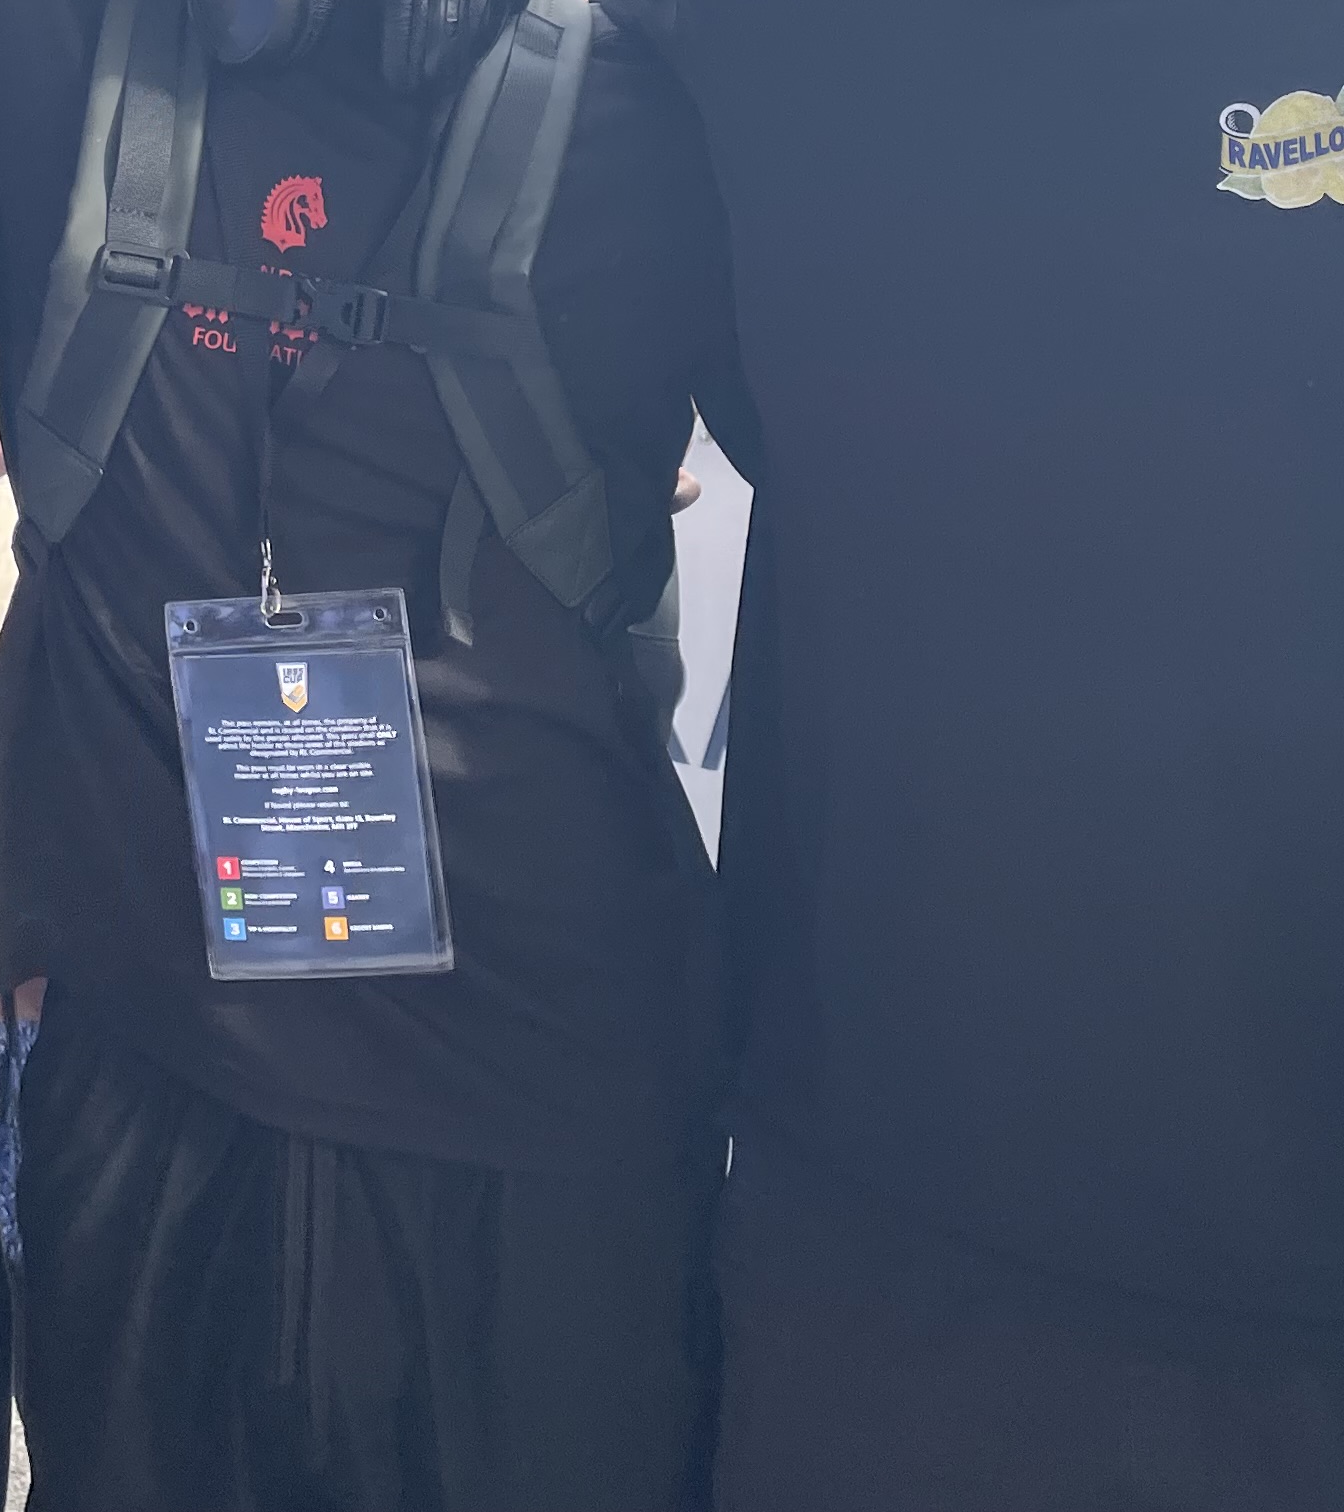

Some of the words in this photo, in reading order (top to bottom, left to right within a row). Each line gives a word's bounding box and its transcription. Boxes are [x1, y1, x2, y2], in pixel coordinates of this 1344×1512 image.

[223, 861, 232, 875] 1
[324, 860, 336, 874] 4
[227, 892, 237, 905] 2
[328, 891, 339, 905] 5
[230, 924, 240, 936] 3
[331, 922, 342, 935] 6
